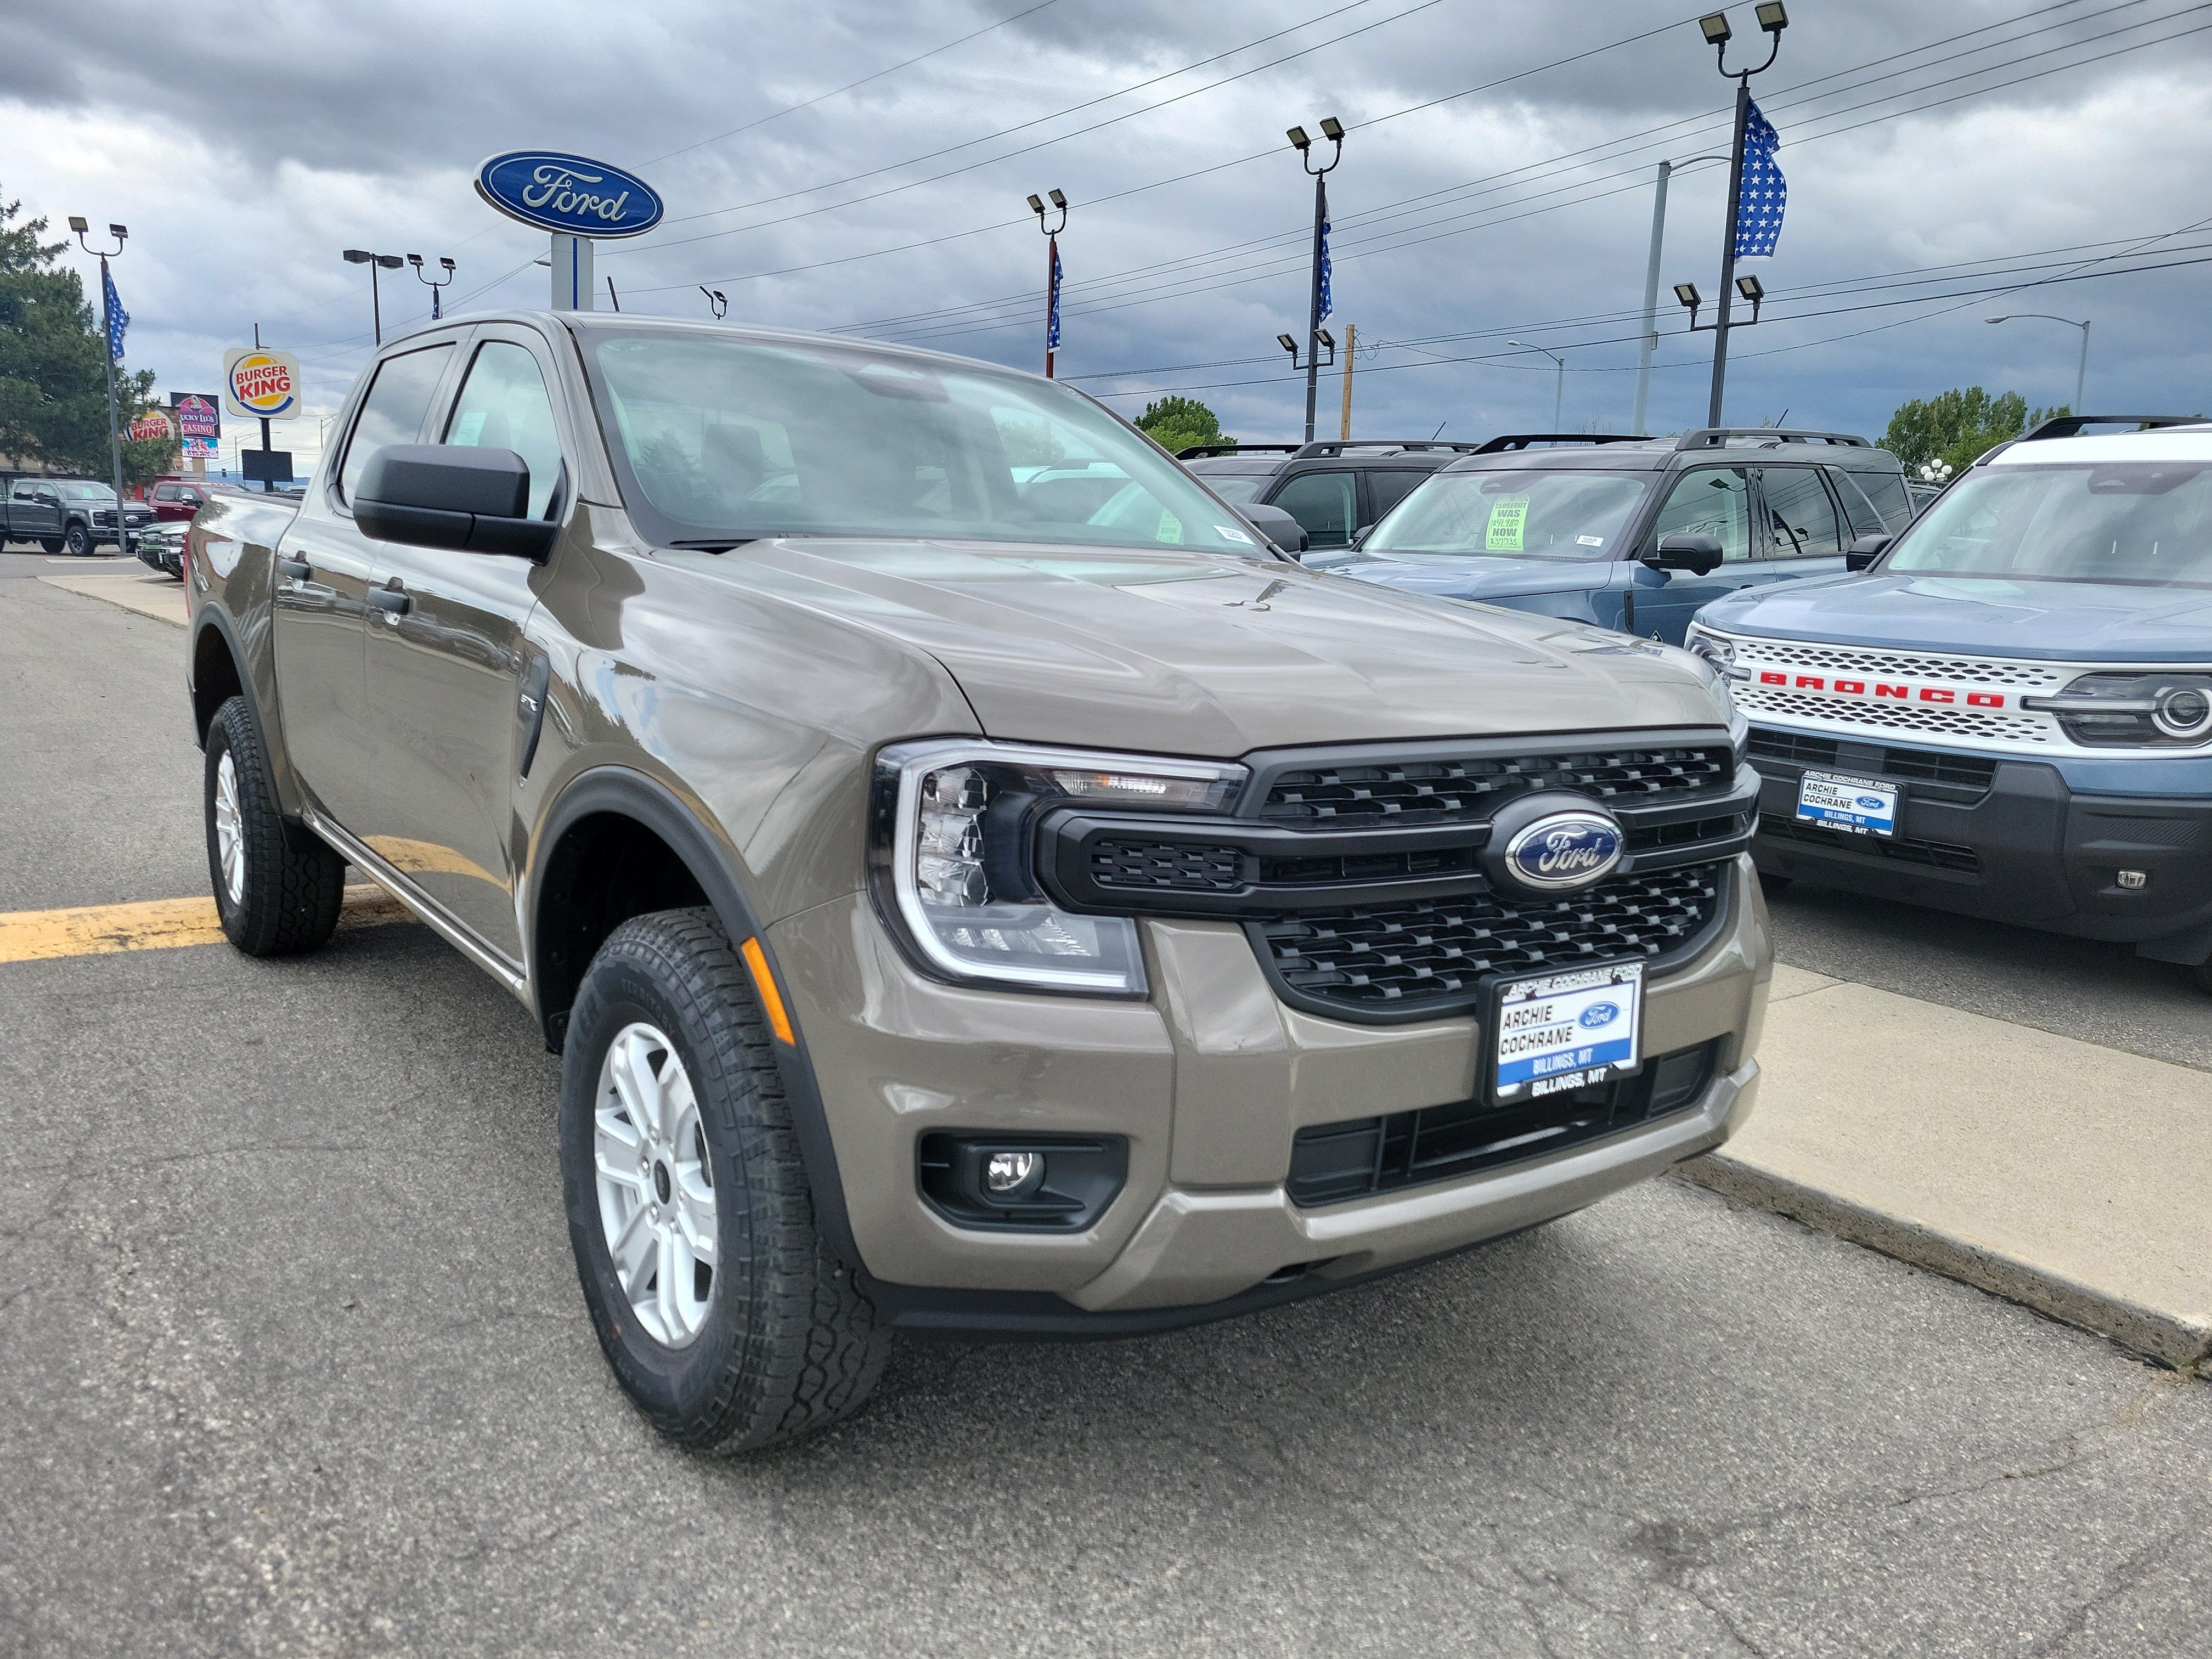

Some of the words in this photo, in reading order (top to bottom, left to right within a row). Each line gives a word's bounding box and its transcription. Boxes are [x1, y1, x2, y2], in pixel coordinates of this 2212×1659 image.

[523, 165, 630, 222] Ford
[236, 366, 288, 385] BURGER
[239, 376, 290, 402] KING
[131, 418, 167, 431] BURGER
[133, 426, 168, 441] KING
[183, 424, 212, 434] CASINO
[1492, 528, 1517, 537] NOW
[1760, 672, 2005, 708] BRONCO
[1804, 770, 1832, 779] ARCHIE
[1832, 775, 1874, 787] COCHRANE
[1805, 782, 1838, 795] ARCHIE
[1803, 793, 1852, 809] COCHRANE
[1860, 798, 1880, 808] Ford
[1824, 810, 1854, 823] BILLINGS,
[1816, 820, 1853, 833] BILLINGS,
[1538, 830, 1602, 872] Ford
[1509, 980, 1552, 997] ARCHIE
[1552, 968, 1613, 989] COCHRANE
[1612, 963, 1643, 978] FORD
[1503, 1004, 1553, 1030] ARCHIE
[1584, 1005, 1612, 1026] Ford
[1500, 1026, 1573, 1056] COCHRANE
[1533, 1052, 1576, 1075] BILLINGS,
[1578, 1048, 1593, 1065] MT
[1531, 1071, 1584, 1097] BILLINGS,
[1587, 1068, 1607, 1084] MT
